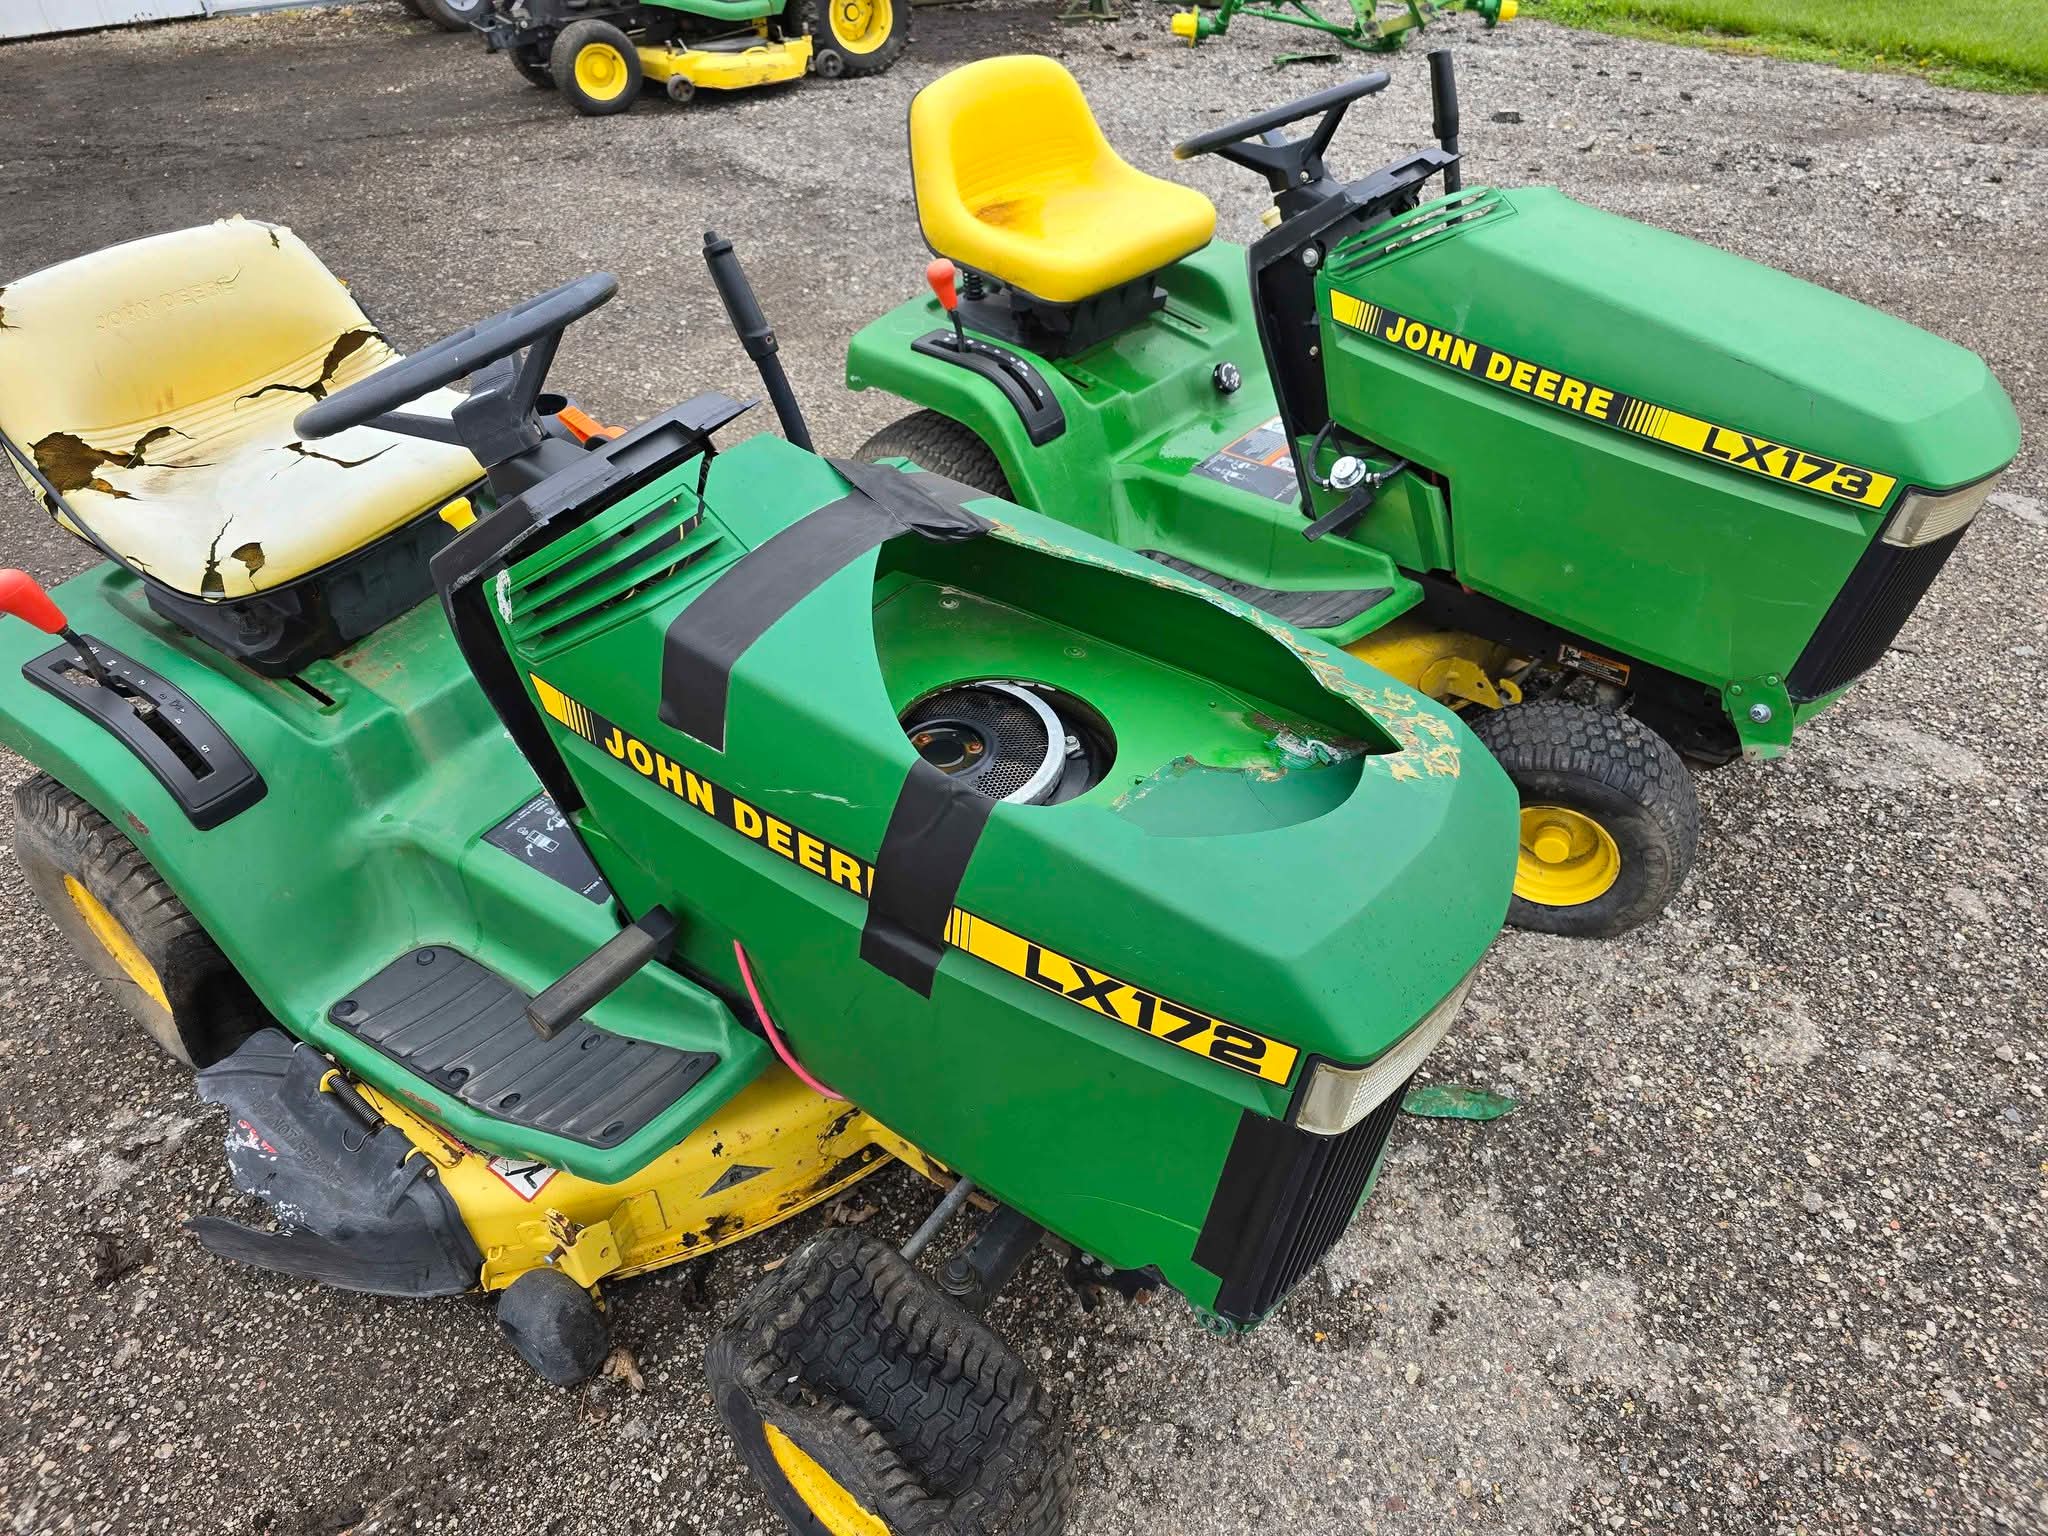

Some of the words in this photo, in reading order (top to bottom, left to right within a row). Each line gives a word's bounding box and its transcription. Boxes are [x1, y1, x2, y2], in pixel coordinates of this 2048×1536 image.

[1385, 317, 1477, 370] JOHN
[1486, 352, 1614, 419] DEERE
[1702, 427, 1872, 499] LX173
[605, 728, 715, 815] JOHN
[1025, 944, 1267, 1074] LX172
